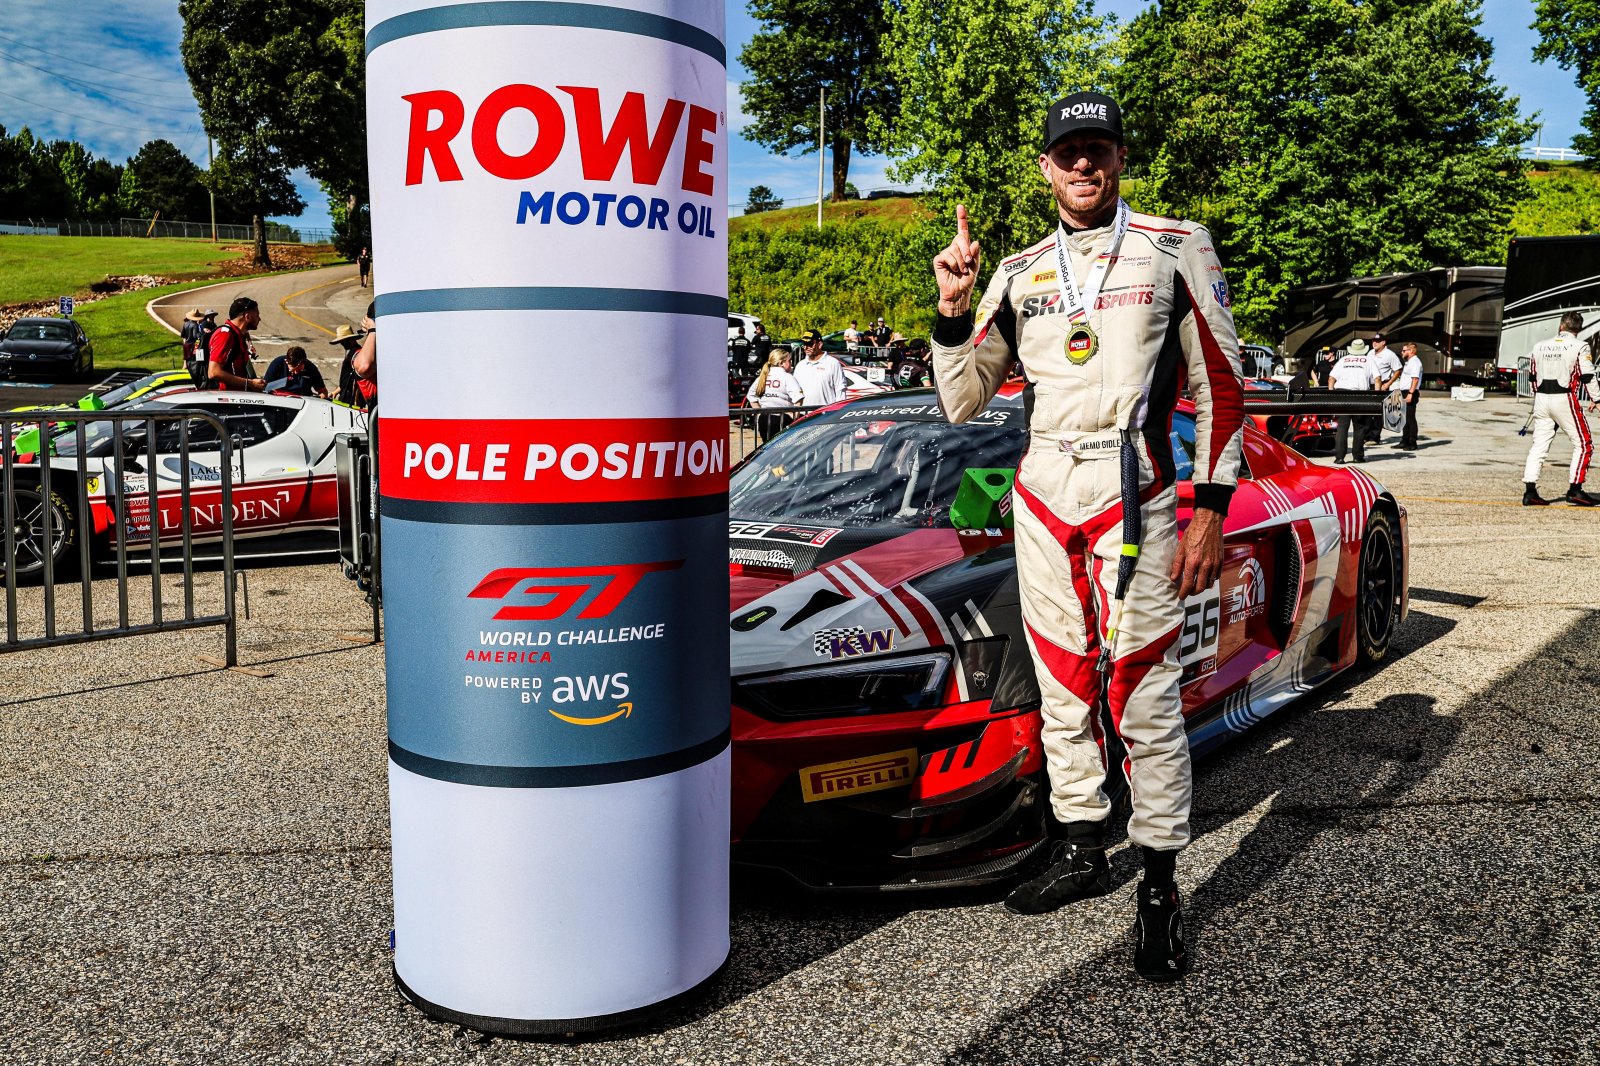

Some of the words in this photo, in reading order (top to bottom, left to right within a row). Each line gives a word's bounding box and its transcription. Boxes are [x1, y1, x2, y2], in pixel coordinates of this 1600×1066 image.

[1060, 102, 1107, 121] ROWE
[401, 84, 717, 197] ROWE
[516, 191, 670, 231] MOTOR
[677, 202, 715, 239] OIL
[1158, 235, 1183, 247] OMP
[1004, 259, 1028, 272] OMP
[1065, 284, 1076, 308] POLE
[1093, 289, 1155, 310] OSPORTS
[1070, 339, 1088, 349] ROWE
[765, 379, 781, 389] RO
[840, 405, 926, 420] powered
[1079, 441, 1101, 451] MEMO
[1101, 438, 1121, 449] GIDLE
[403, 442, 510, 481] POLE
[523, 439, 724, 481] POSITION
[160, 498, 282, 531] LNDEN
[731, 548, 769, 561] OPERATION
[467, 558, 687, 621] GT
[1228, 603, 1265, 625] AUTOSPORTS
[479, 630, 552, 646] WORLD
[557, 623, 665, 646] CHALLENGE
[1181, 596, 1220, 658] 56
[830, 628, 896, 660] KW
[465, 649, 552, 663] AMERICA
[465, 675, 542, 689] POWERED
[552, 672, 630, 704] aws
[521, 692, 542, 704] BY
[810, 756, 910, 796] PIRELLI
